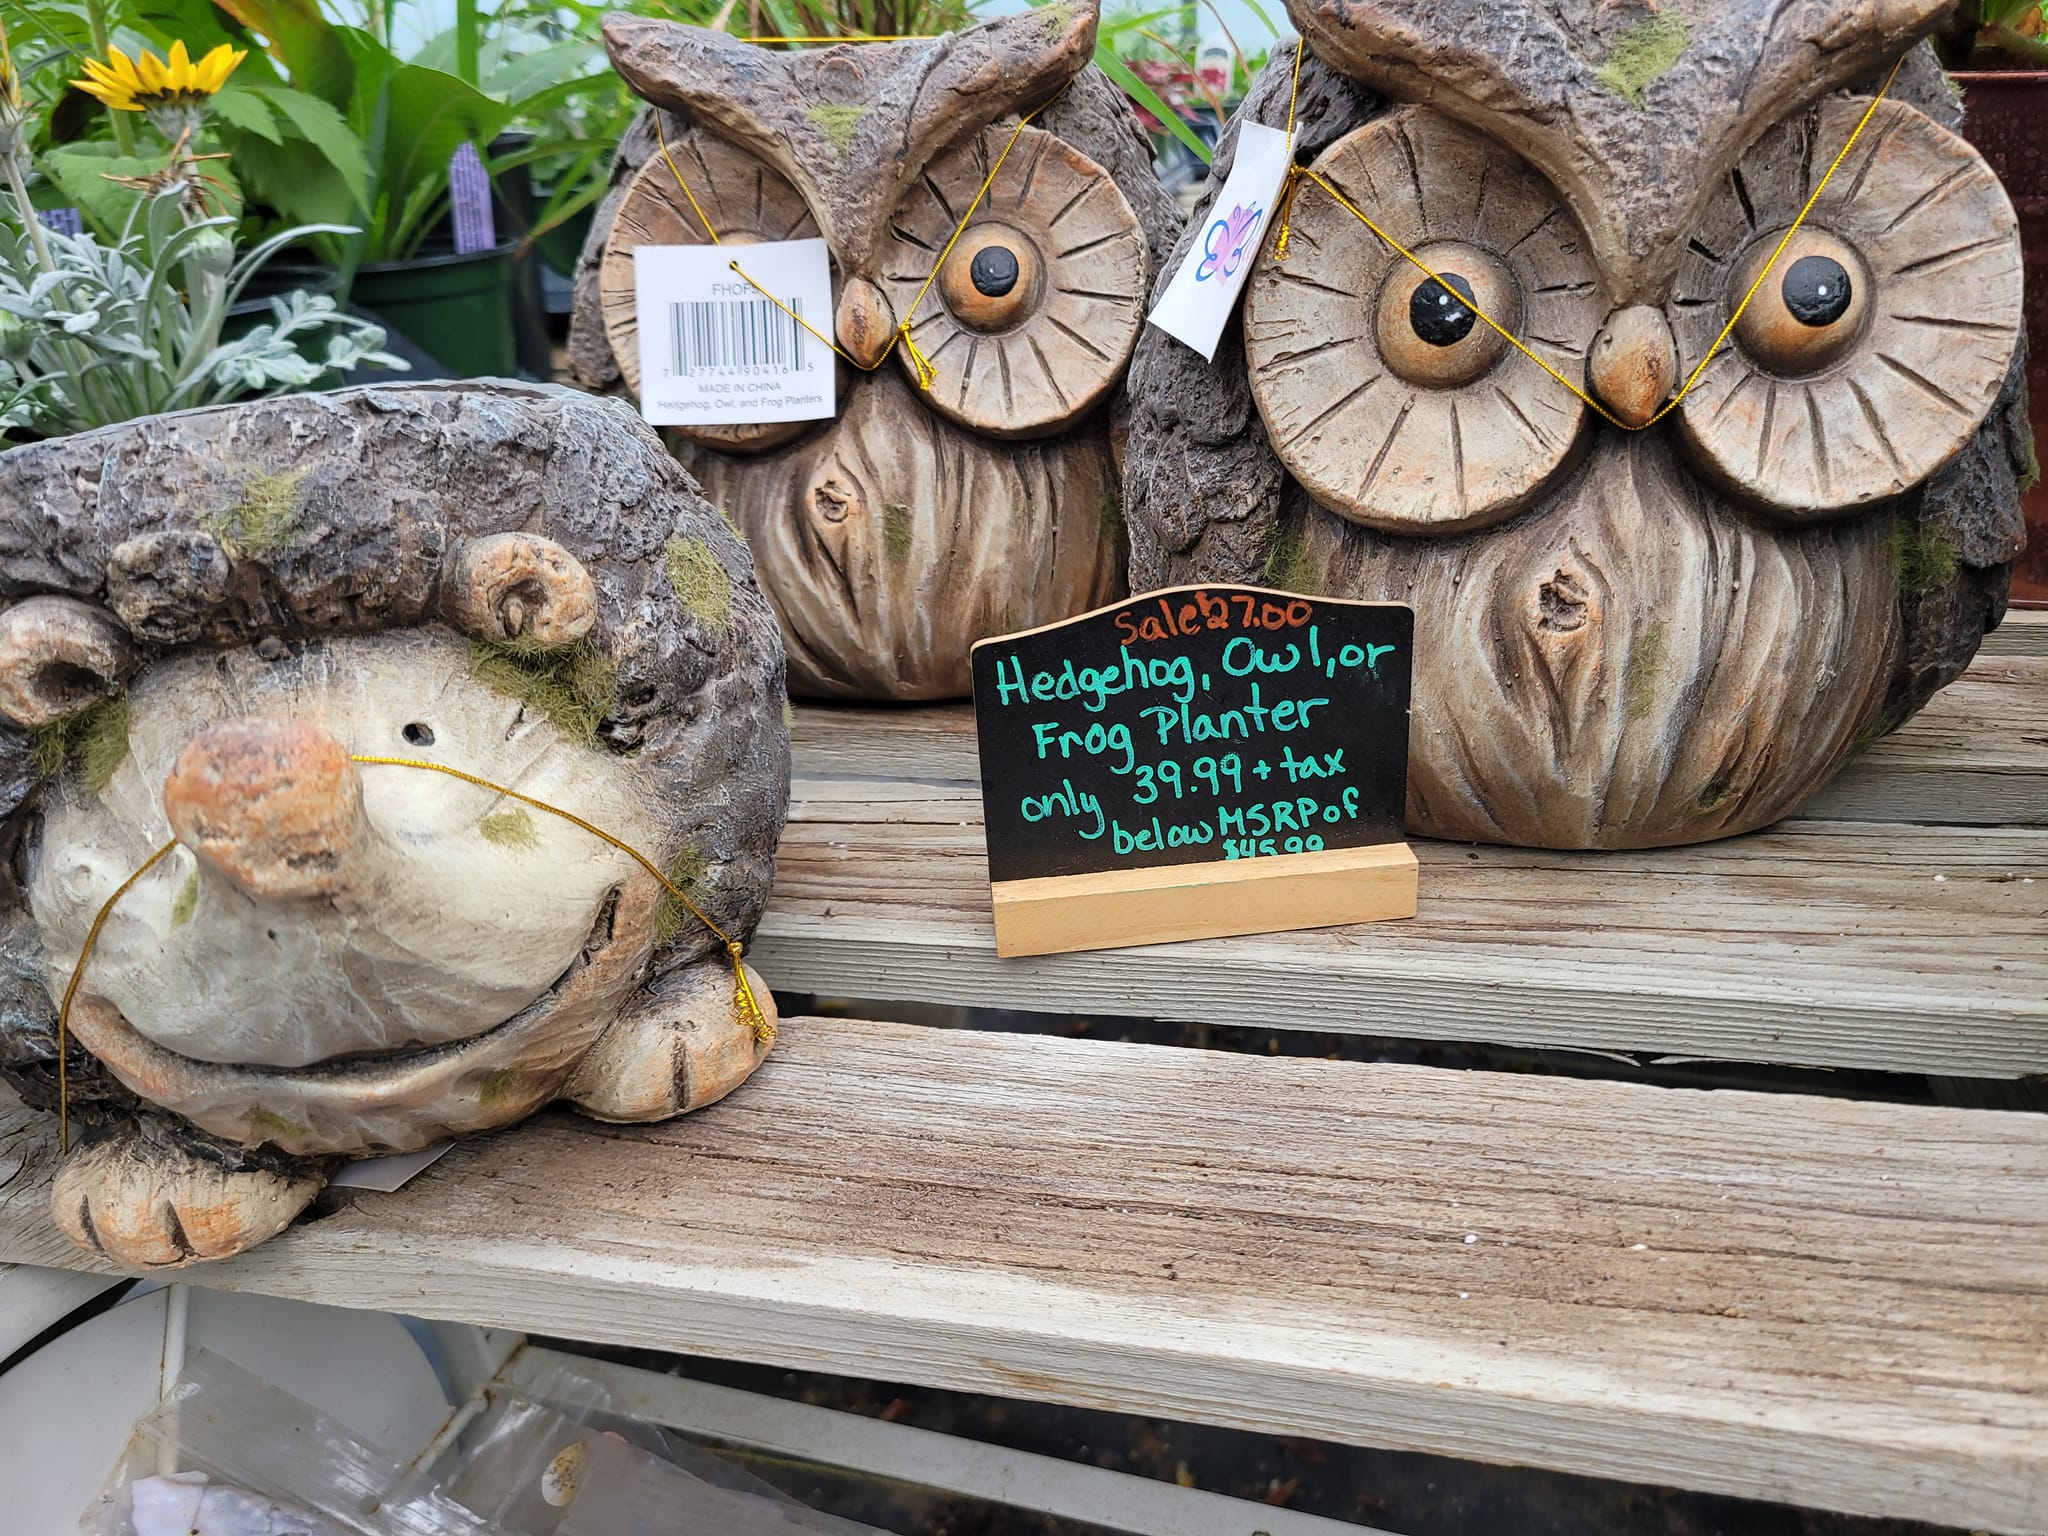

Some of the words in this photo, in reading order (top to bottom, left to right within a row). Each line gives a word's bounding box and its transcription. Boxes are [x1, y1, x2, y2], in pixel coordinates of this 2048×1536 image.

[699, 383, 731, 393] MADE
[734, 383, 745, 393] IN
[747, 381, 781, 392] CHINA
[740, 399, 758, 408] and
[761, 397, 783, 408] Frog
[785, 394, 823, 405] Planters
[1114, 598, 1200, 646] Sale
[997, 645, 1210, 712] Hedgehog,
[1032, 721, 1134, 775] Frog
[1139, 682, 1330, 746] Planter
[1020, 779, 1106, 840] only
[1132, 752, 1242, 804] 39.99
[1280, 745, 1347, 784] tax
[1112, 817, 1214, 855] below
[1217, 796, 1319, 836] MSRP
[1322, 786, 1360, 824] of
